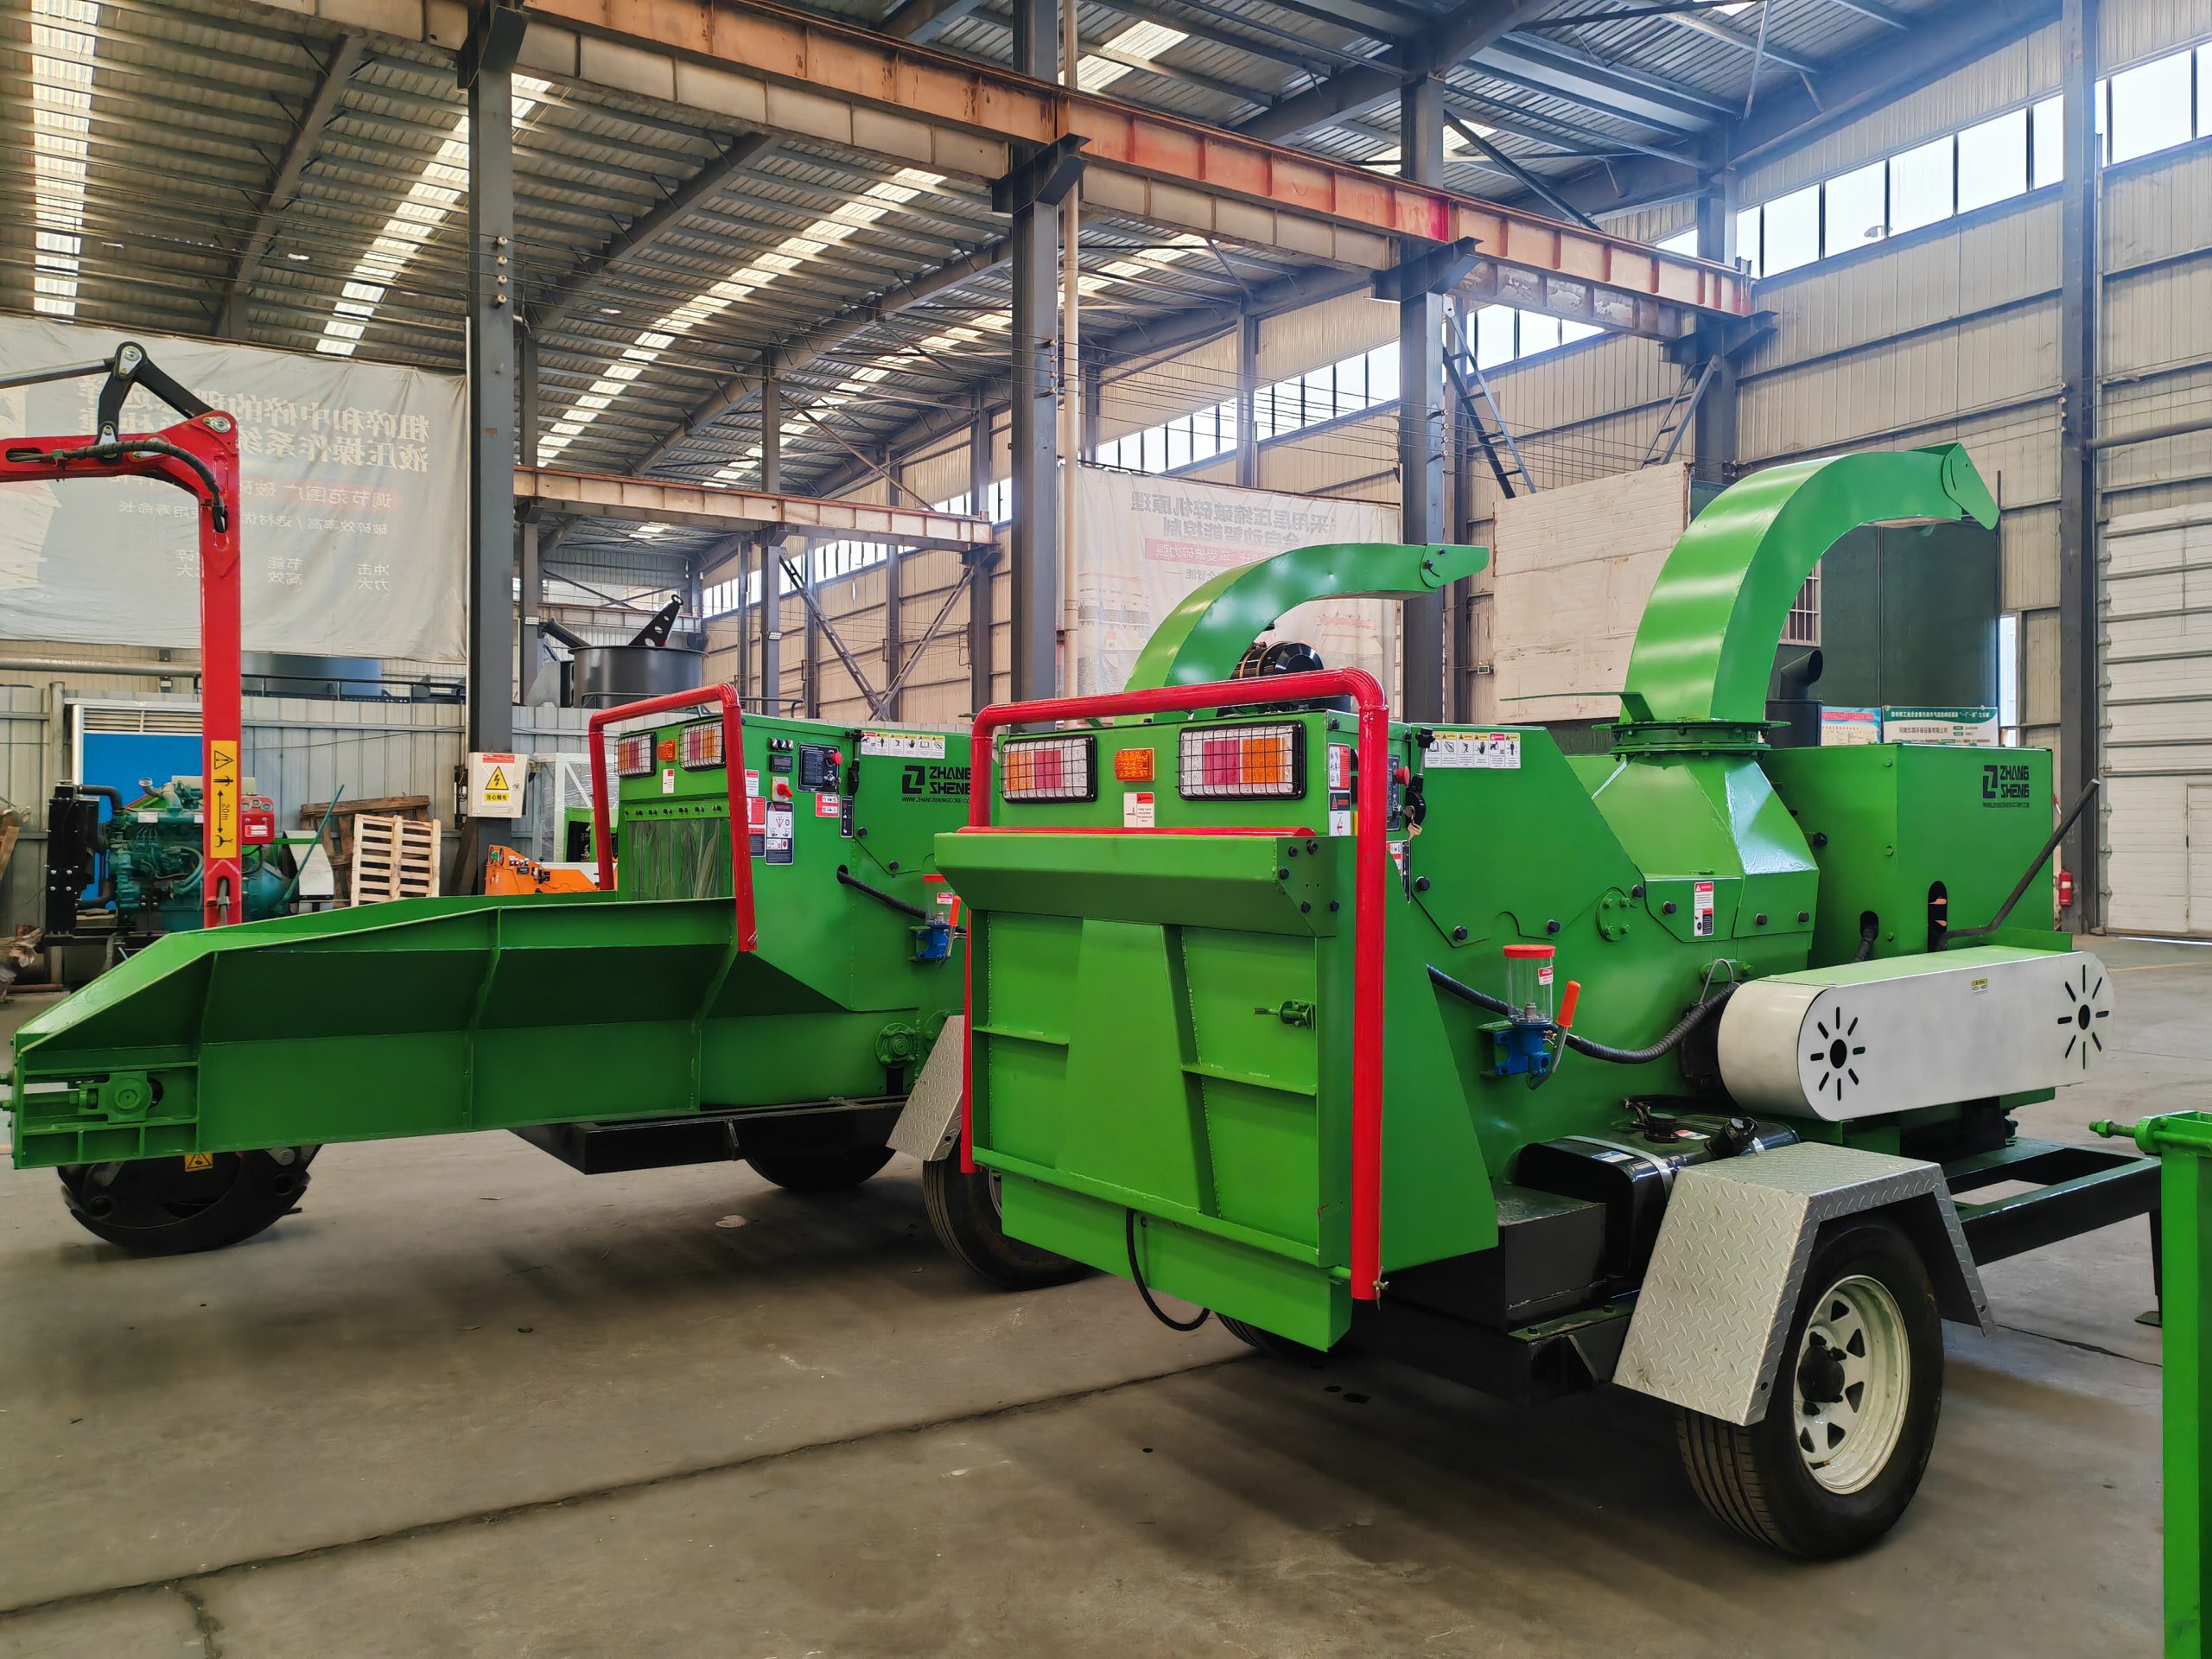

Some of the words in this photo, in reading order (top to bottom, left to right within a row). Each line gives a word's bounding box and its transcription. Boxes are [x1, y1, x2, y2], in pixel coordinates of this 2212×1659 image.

[1999, 765, 2030, 781] ZHANG
[2000, 784, 2030, 798] SHENG
[221, 803, 231, 822] 20m
